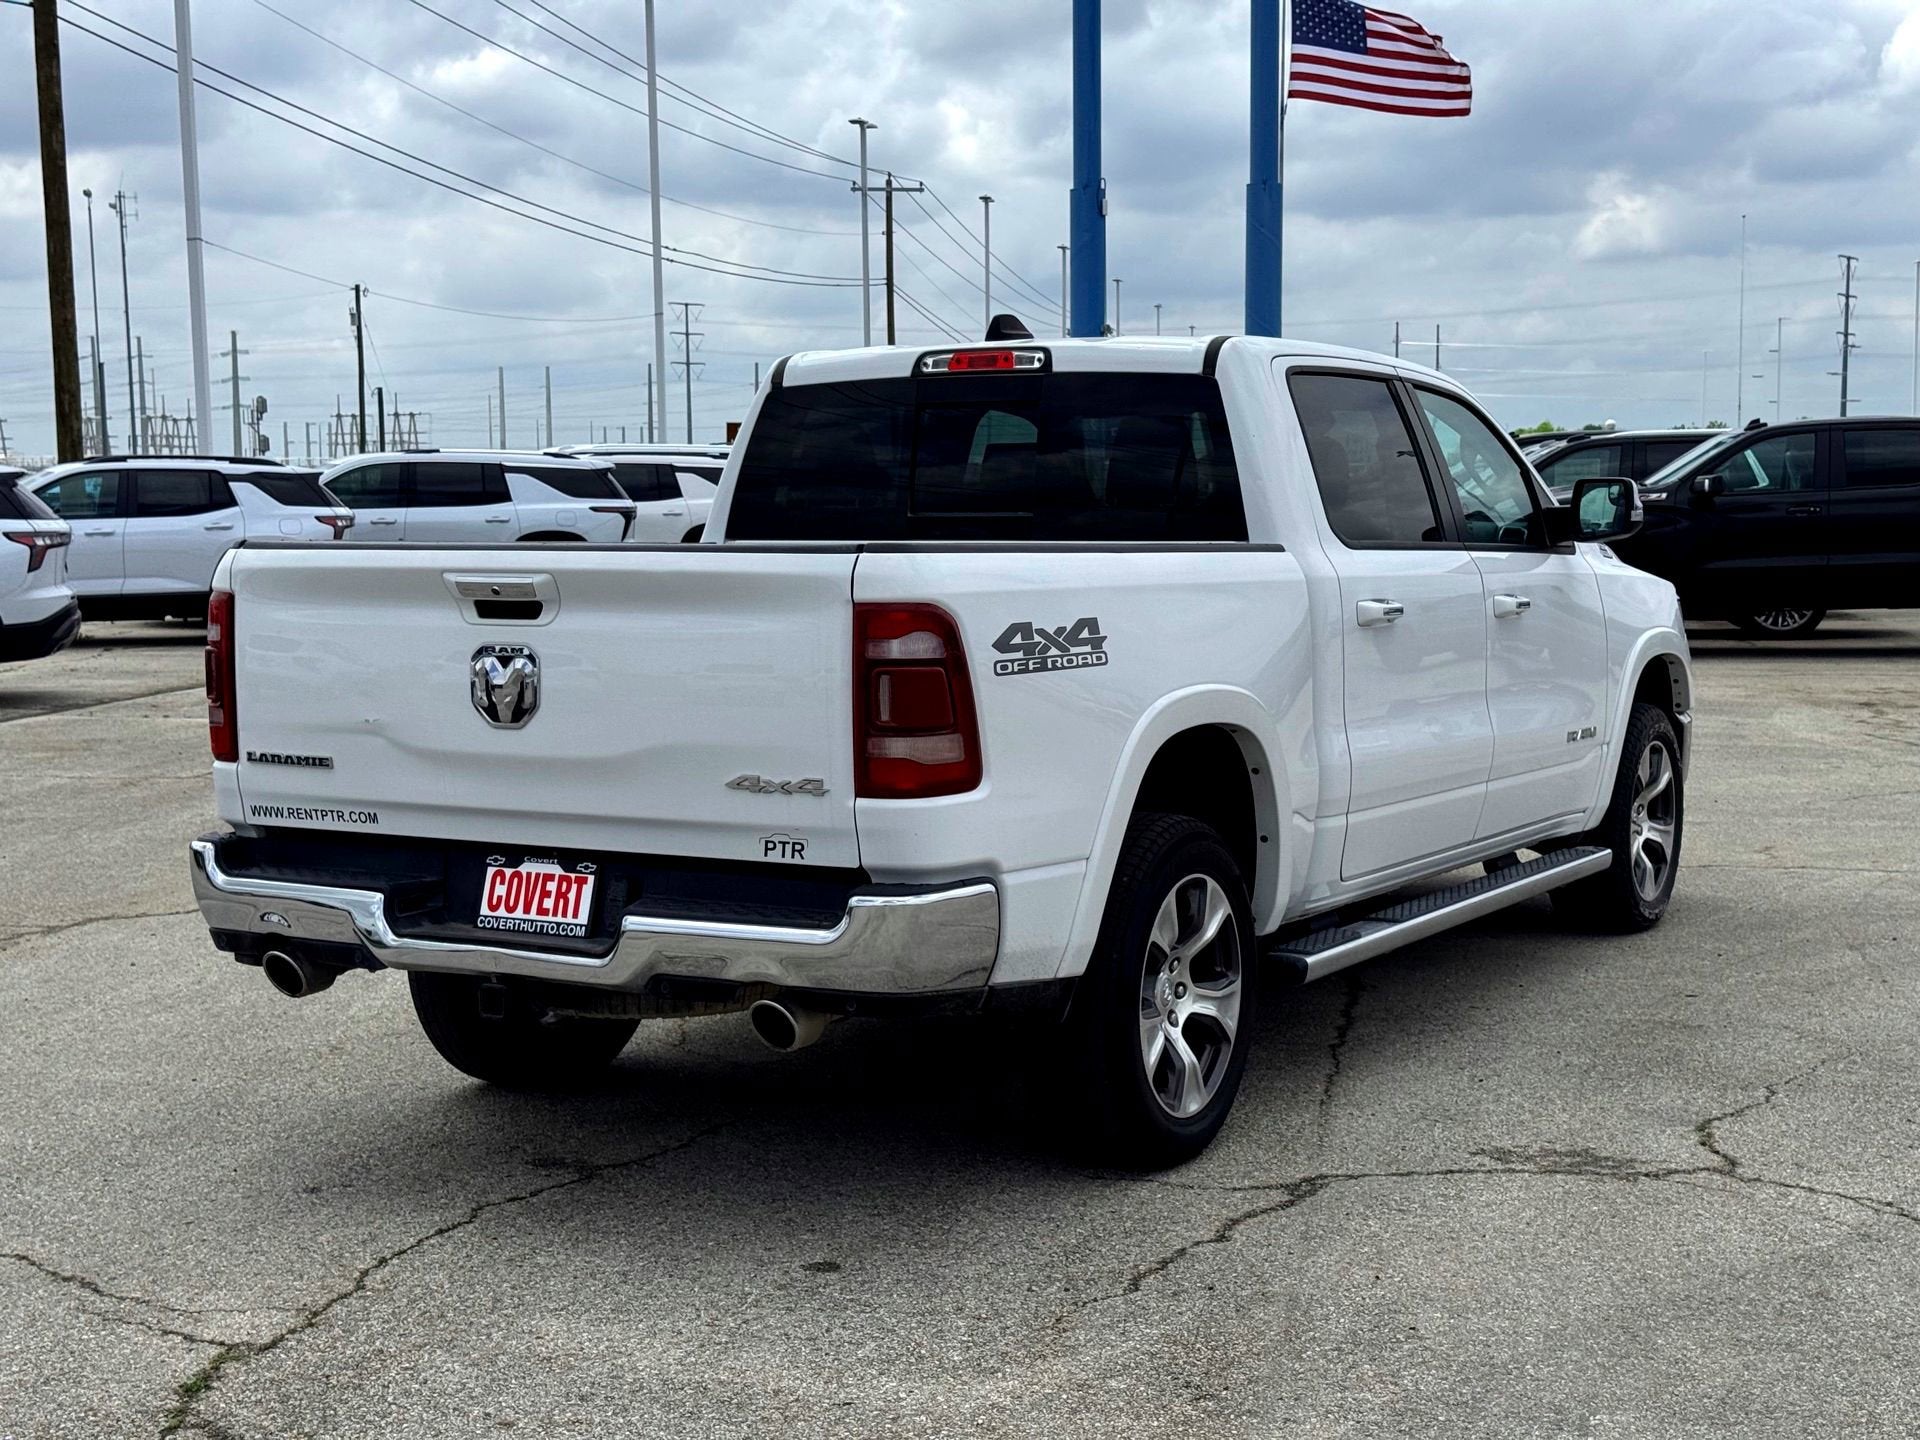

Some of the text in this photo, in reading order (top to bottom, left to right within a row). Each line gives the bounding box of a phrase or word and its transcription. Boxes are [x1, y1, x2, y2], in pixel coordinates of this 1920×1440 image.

[991, 617, 1108, 657] 4x4
[482, 645, 530, 656] RAM
[996, 653, 1107, 674] OFF ROAD
[246, 751, 333, 769] LARAMIE
[724, 774, 831, 797] 4x4
[250, 804, 379, 825] WWW.RENTPTR.COM
[523, 856, 558, 865] Covert
[764, 840, 805, 860] PTR
[487, 868, 589, 919] COVERT
[477, 916, 586, 937] COVERTHUTTO.COM
